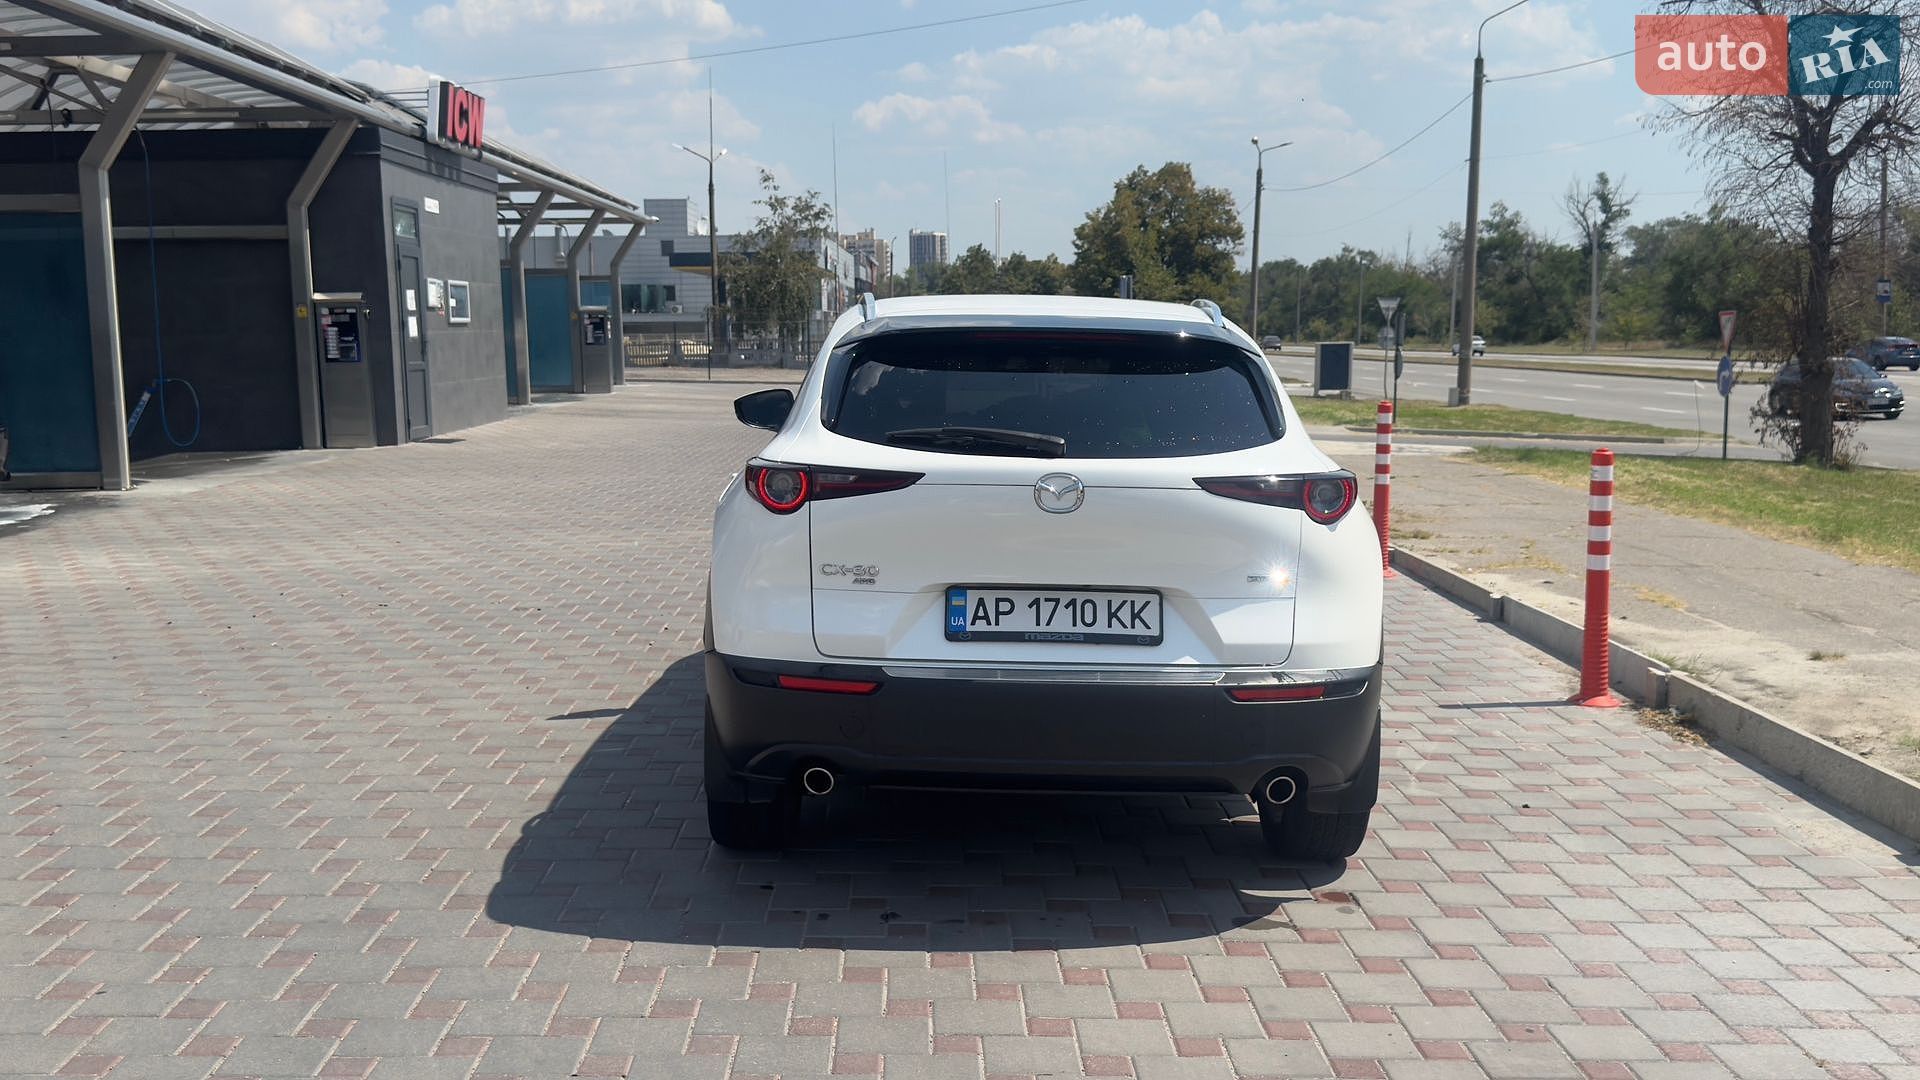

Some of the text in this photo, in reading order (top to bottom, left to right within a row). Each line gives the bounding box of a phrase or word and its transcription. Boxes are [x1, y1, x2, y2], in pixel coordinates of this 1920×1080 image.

[446, 84, 486, 148] ICW
[821, 563, 880, 577] CX-30
[951, 616, 965, 626] UA
[970, 597, 1152, 630] AP 1710 KK
